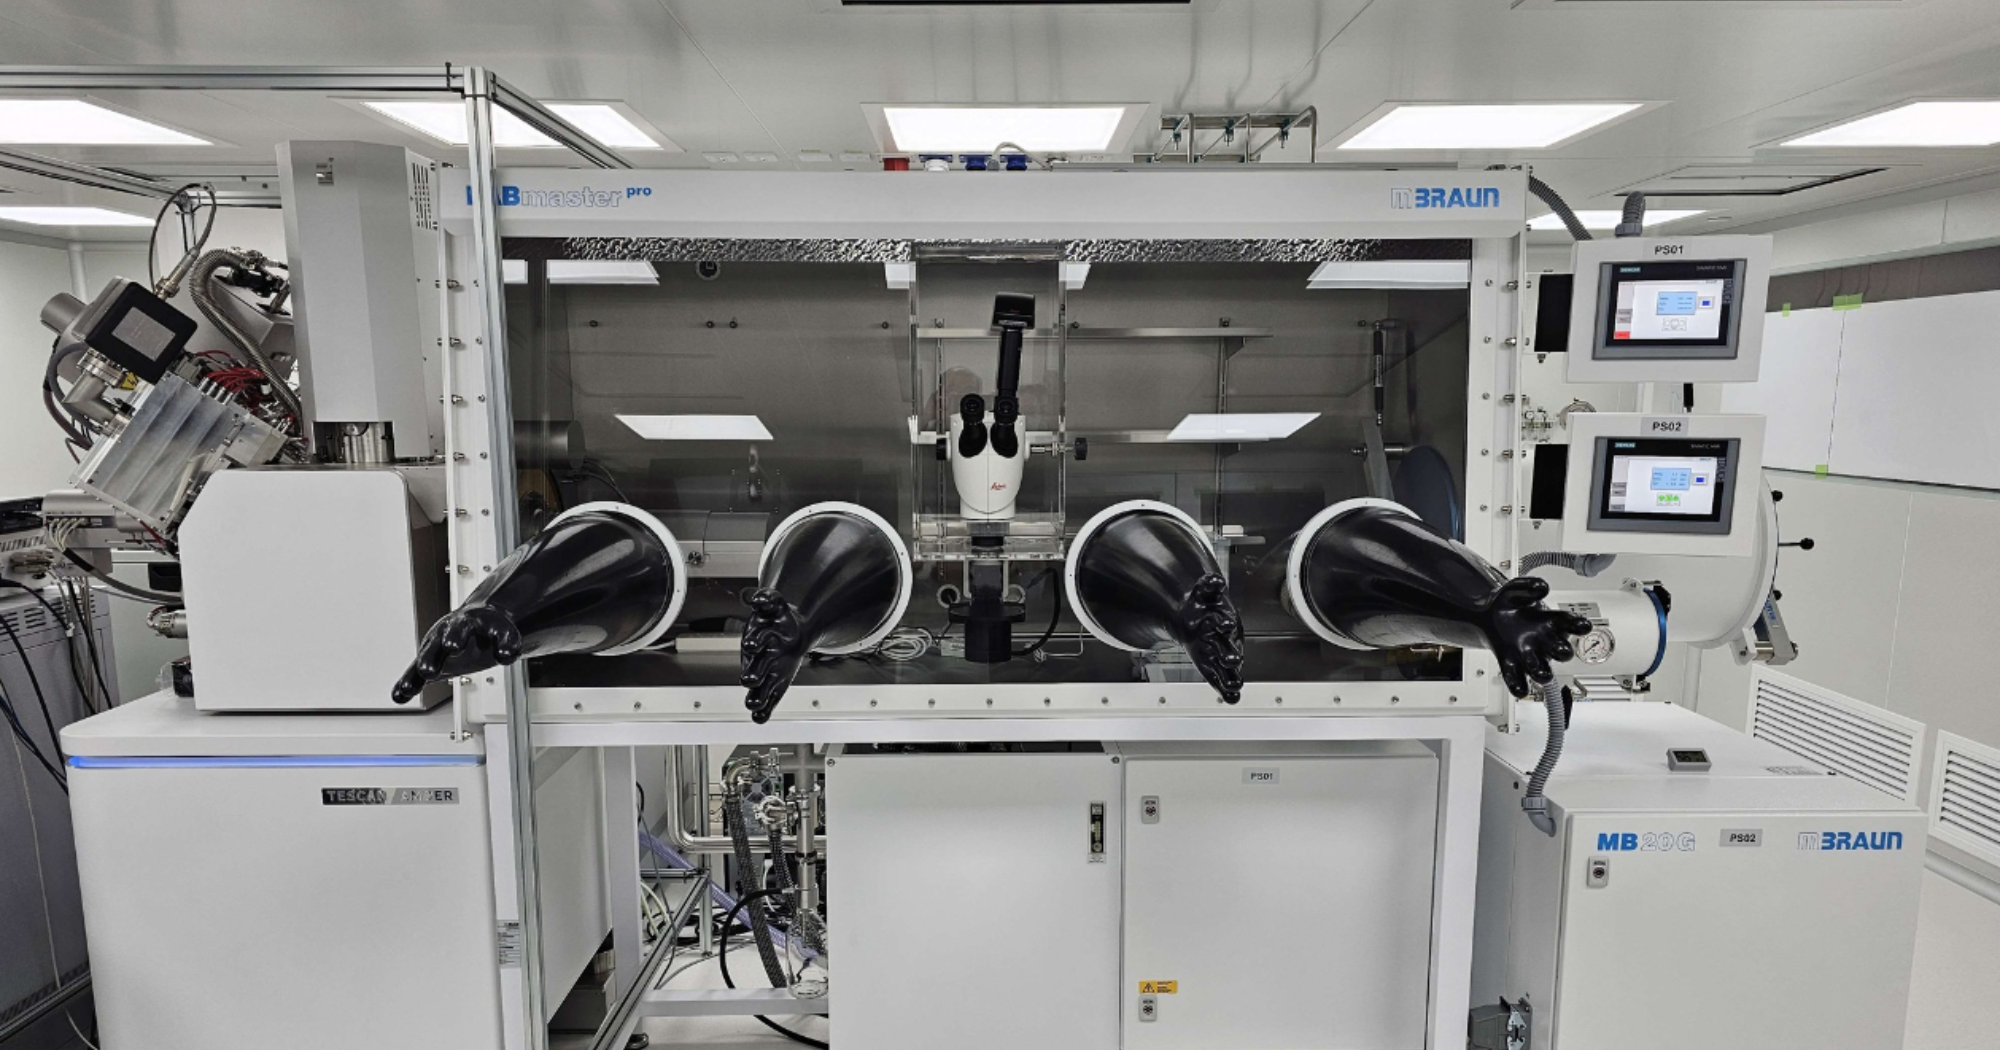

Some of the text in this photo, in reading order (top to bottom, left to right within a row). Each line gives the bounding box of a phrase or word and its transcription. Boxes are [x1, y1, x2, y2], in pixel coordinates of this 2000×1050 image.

[466, 186, 652, 207] Bmaster pro
[1654, 245, 1684, 255] PS01
[1652, 421, 1682, 432] PS02
[326, 789, 387, 802] TESCAN
[1729, 833, 1756, 842] PS02
